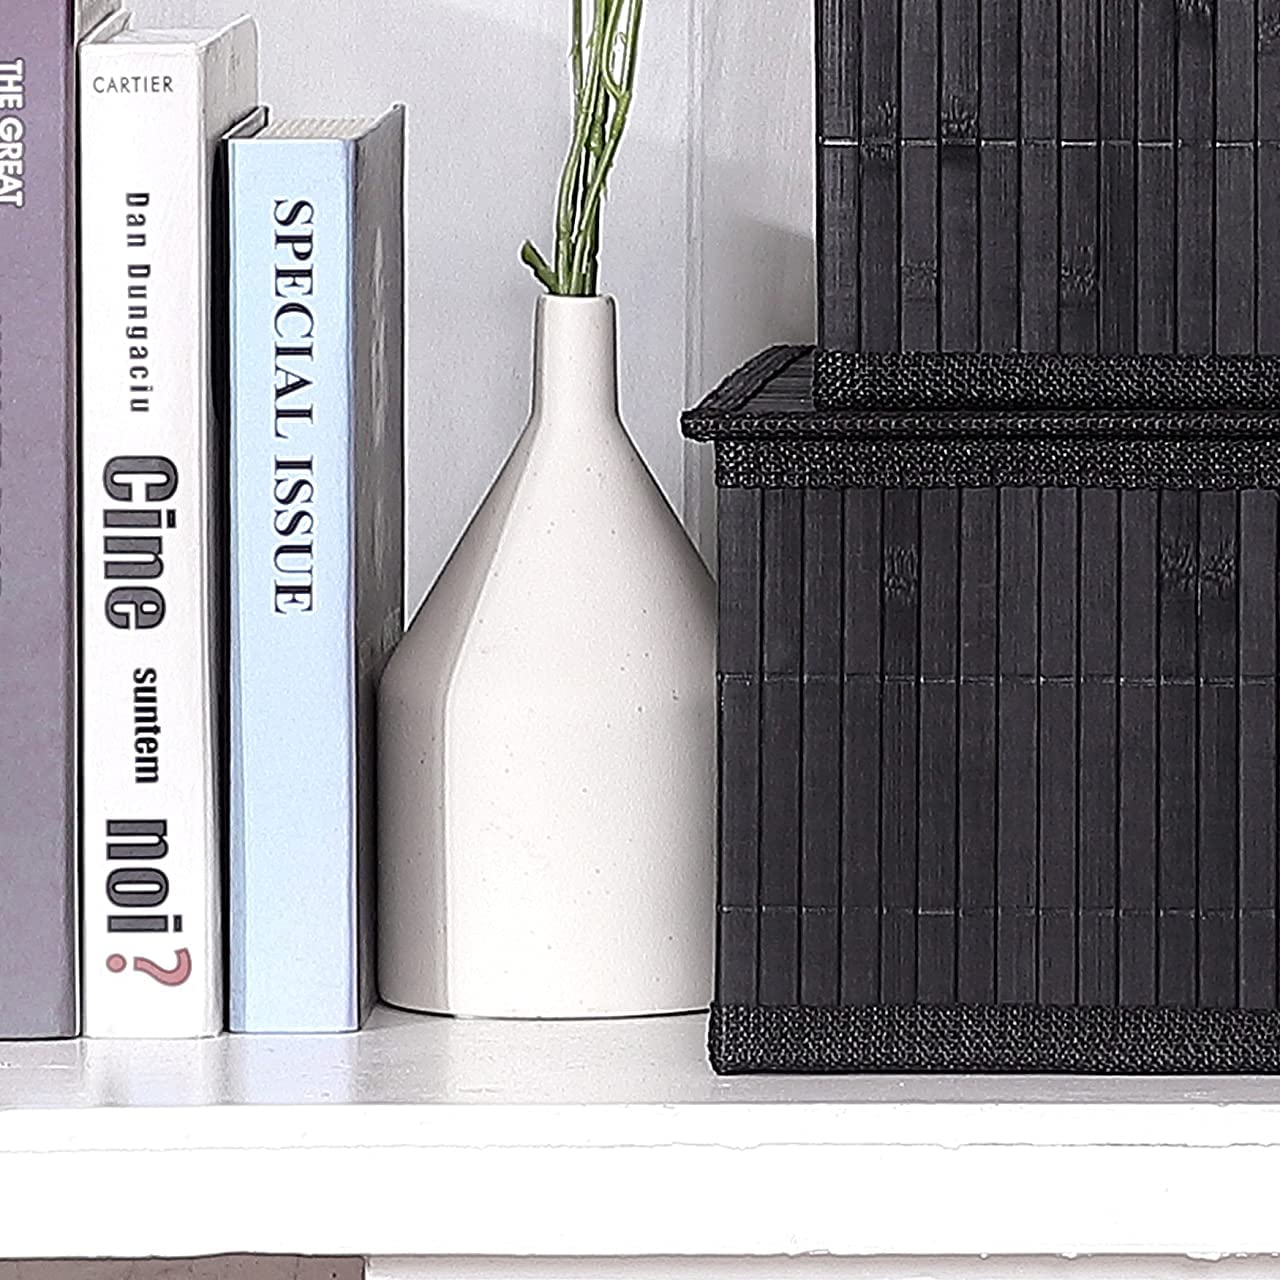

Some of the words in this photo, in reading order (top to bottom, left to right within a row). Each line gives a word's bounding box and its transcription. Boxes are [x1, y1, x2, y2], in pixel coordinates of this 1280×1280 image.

[0, 59, 24, 109] THE
[92, 75, 174, 94] CARTIER
[0, 117, 24, 207] GREAT
[125, 192, 151, 248] Dan
[125, 264, 155, 412] Dungaciu
[273, 199, 315, 439] SPECIAL
[102, 455, 179, 630] Cine
[273, 456, 315, 614] ISSUE
[132, 667, 162, 784] suntem
